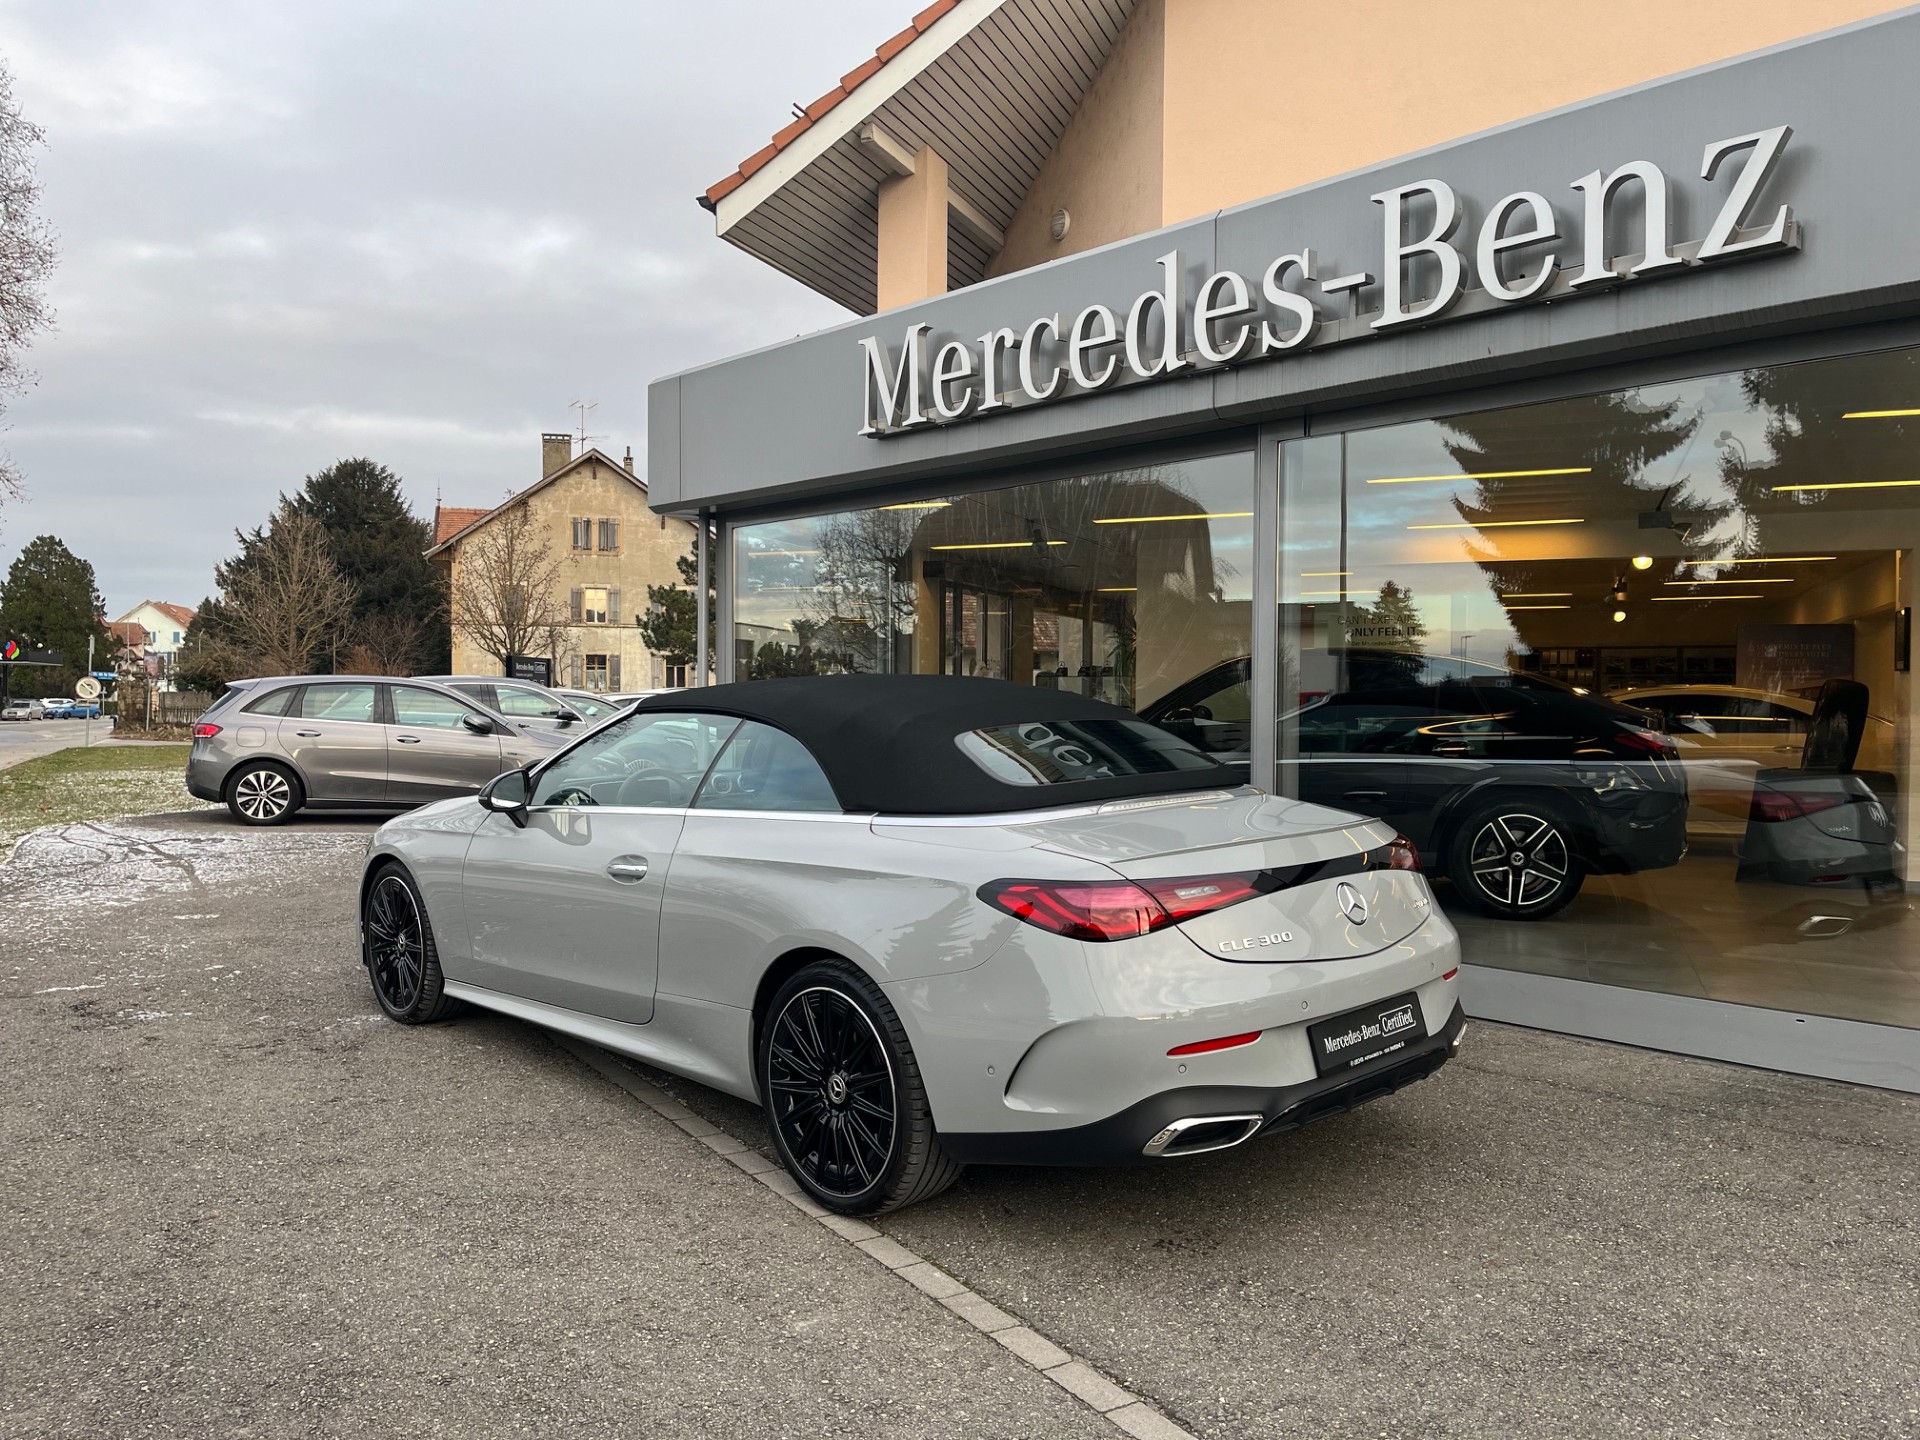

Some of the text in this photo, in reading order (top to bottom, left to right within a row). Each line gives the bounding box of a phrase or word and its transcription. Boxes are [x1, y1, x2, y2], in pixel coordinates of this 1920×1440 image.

[858, 125, 1797, 439] Mercedes-Benz
[1371, 614, 1412, 624] EXPAIN
[1378, 626, 1404, 637] FEEL
[1218, 931, 1293, 953] CLE 300
[1324, 1022, 1382, 1054] Mercedes-Benz
[1382, 1008, 1414, 1032] Certified
